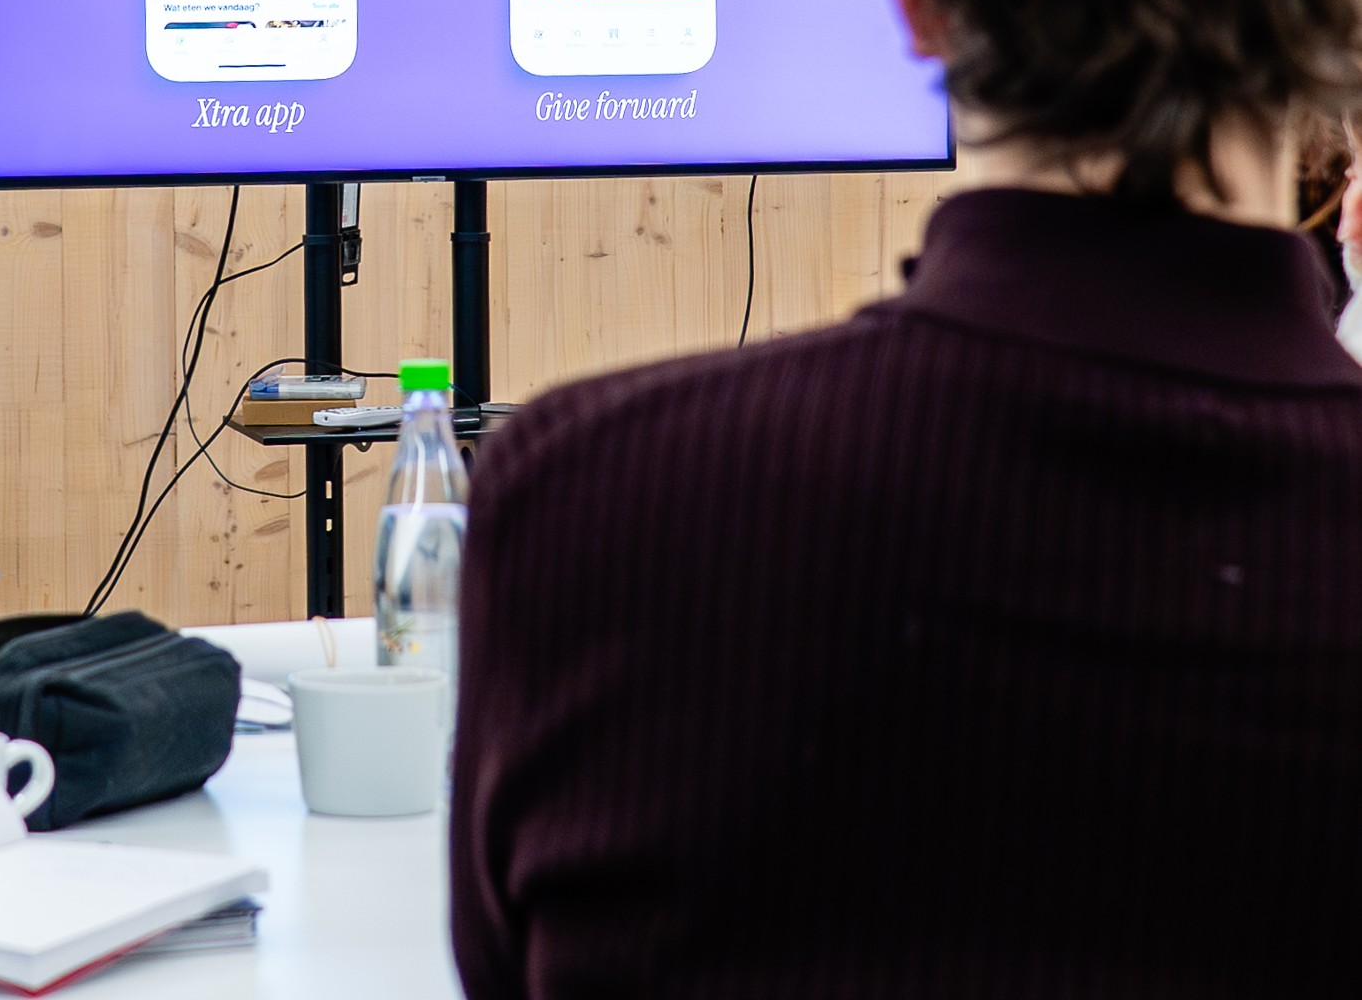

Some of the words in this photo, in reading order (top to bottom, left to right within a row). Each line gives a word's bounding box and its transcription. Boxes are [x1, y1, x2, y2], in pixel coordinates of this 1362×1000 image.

[163, 3, 181, 12] Wat
[182, 3, 202, 12] eten
[203, 4, 216, 12] we
[217, 2, 261, 13] vandaag?
[190, 98, 251, 128] Xtra
[255, 101, 306, 134] app
[535, 91, 591, 122] Give
[594, 88, 699, 121] forward
